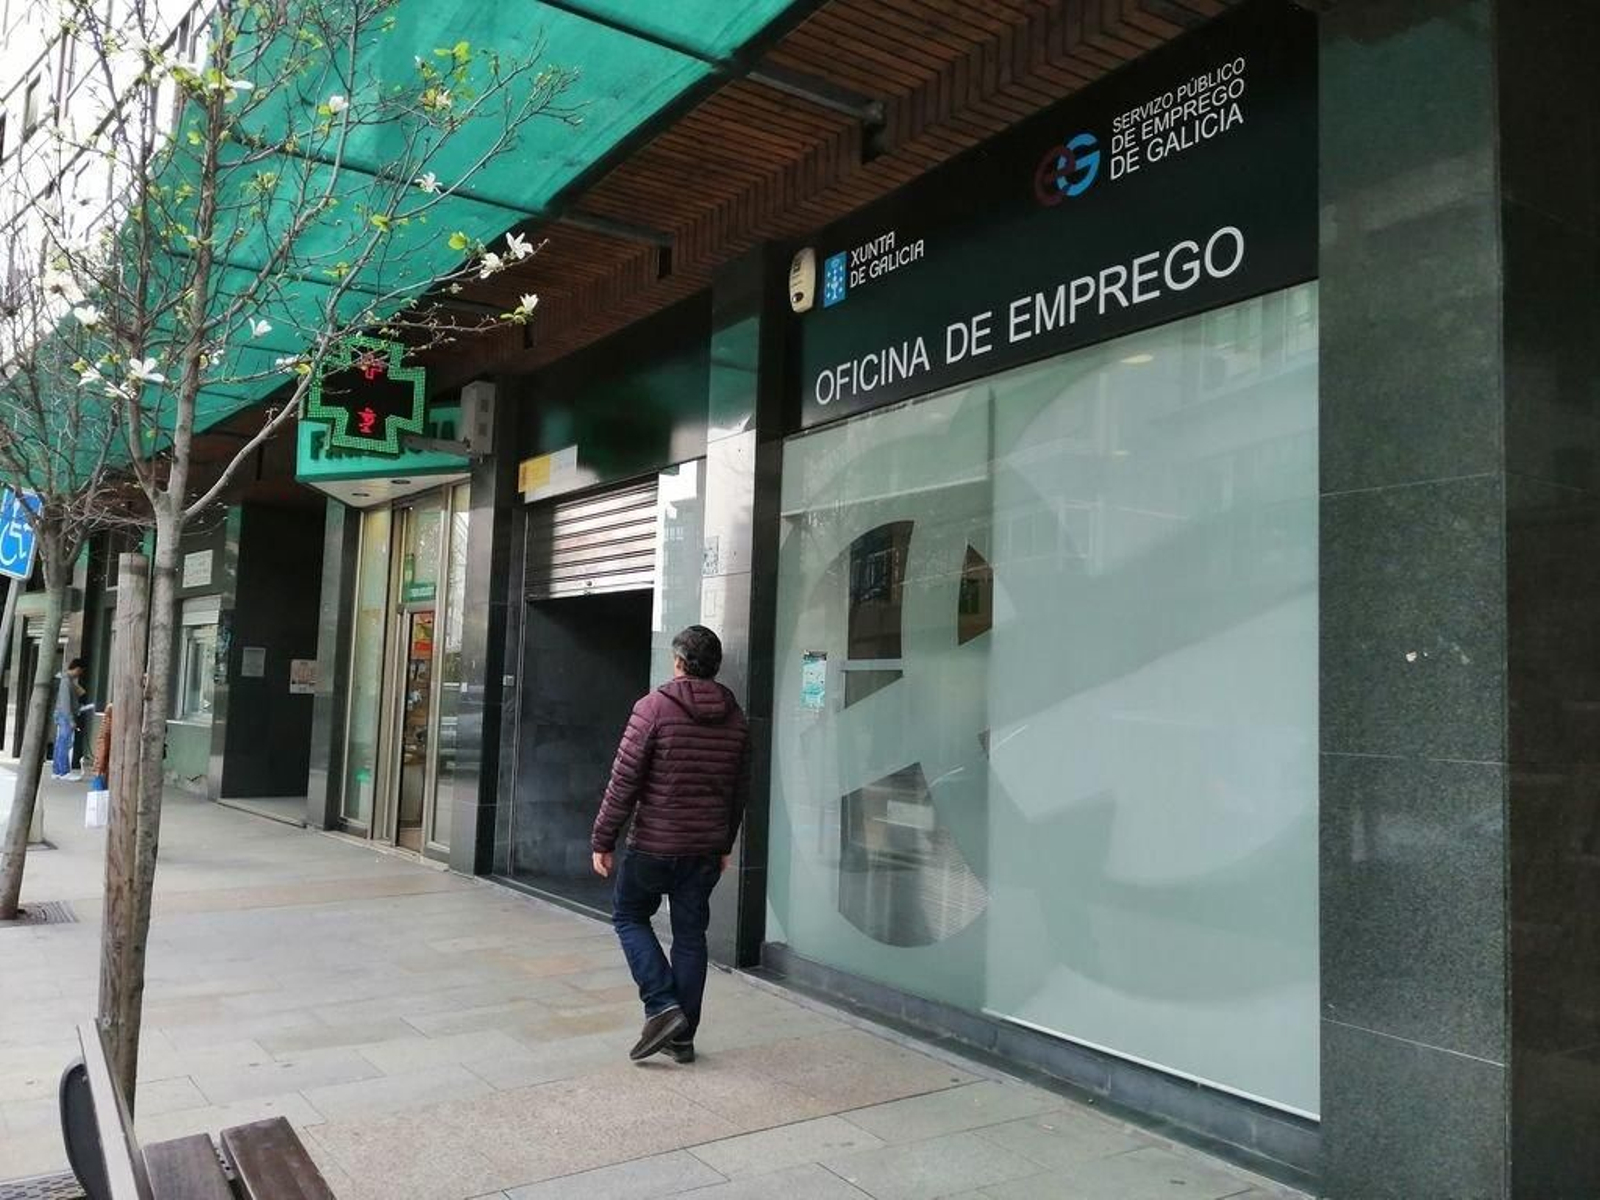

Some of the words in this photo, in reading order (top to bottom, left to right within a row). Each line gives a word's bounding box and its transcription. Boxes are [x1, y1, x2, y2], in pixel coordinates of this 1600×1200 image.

[1111, 127, 1136, 154] DE
[1141, 77, 1245, 141] EMPREGO
[1113, 91, 1174, 133] SERVIZO
[1177, 57, 1246, 102] PÚBLICO
[1110, 147, 1139, 180] DE
[1147, 102, 1244, 162] GALICIA
[850, 231, 895, 268] XUNTA
[850, 266, 866, 288] DE
[869, 239, 924, 278] GALICIA
[815, 336, 930, 406] OFICINA
[946, 311, 993, 365] DE
[1008, 225, 1245, 344] EMPREGO
